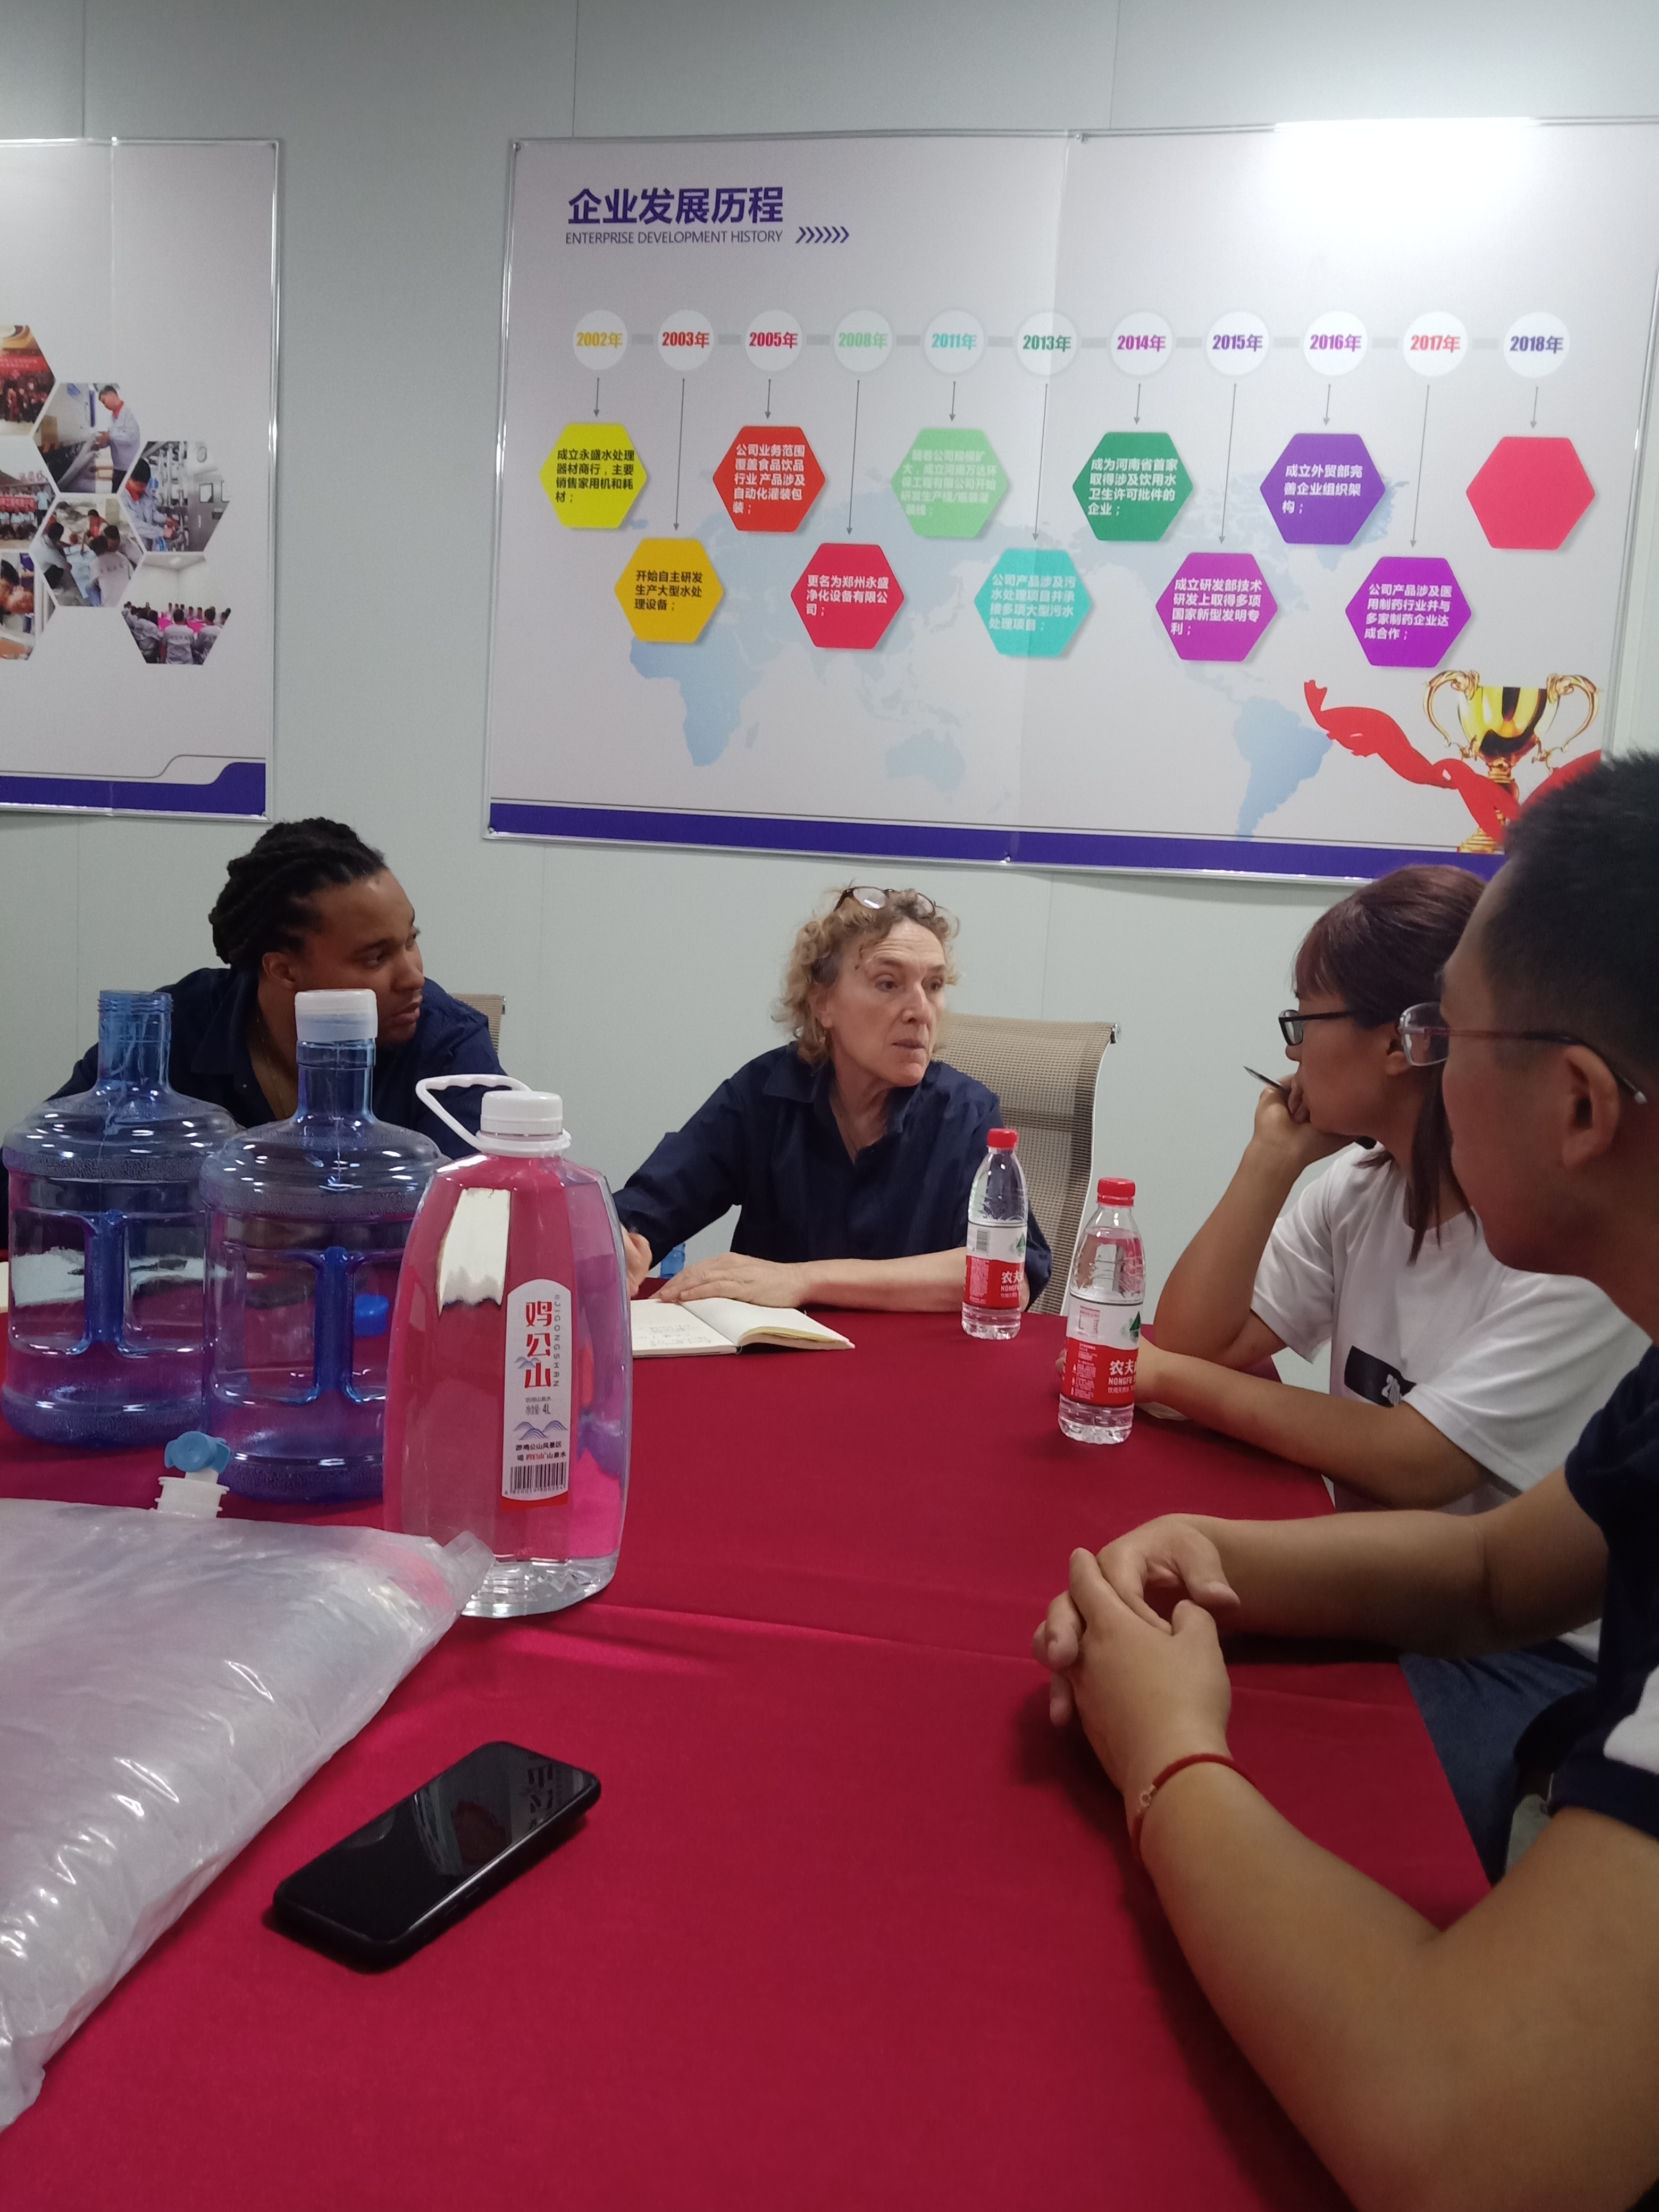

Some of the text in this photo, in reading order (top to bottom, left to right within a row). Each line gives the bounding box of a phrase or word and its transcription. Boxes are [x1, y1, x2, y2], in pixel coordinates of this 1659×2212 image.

[568, 187, 783, 224] 企业发展历程
[565, 230, 783, 244] ENTERPRISE DEVELOPMENT HISTORY
[577, 331, 623, 349] 2002年
[662, 331, 710, 349] 2003年
[749, 331, 798, 349] 2005年
[839, 332, 887, 350] 2008年
[932, 333, 977, 350] 2011年
[1023, 334, 1071, 352] 2013年
[1118, 334, 1166, 353] 2014年
[1212, 334, 1263, 352] 2015年
[1310, 334, 1362, 353] 2016年
[1410, 334, 1461, 353] 2017年
[1510, 336, 1563, 354] 2018年
[557, 449, 634, 461] 成立永盛水处理
[736, 443, 806, 457] 公司业务范围
[735, 458, 804, 472] 覆盖食品饮品
[1091, 457, 1178, 472] 成为河南省首家
[1285, 463, 1363, 479] 成立外贸部完
[556, 477, 633, 490] 销售家用机和耗
[1090, 472, 1177, 487] 取得涉及饮用水
[734, 487, 802, 501] 自动化灌装包
[1088, 487, 1176, 501] 卫生许可批件的
[1284, 481, 1361, 497] 善企业组织架
[636, 570, 703, 583] 开始自主研发
[807, 574, 889, 590] 更名为郑州永盛
[1174, 577, 1263, 592] 成立研发部技术
[635, 584, 702, 598] 生产大型水处
[806, 589, 888, 604] 净化设备有限公
[1369, 583, 1453, 598] 公司产品涉及医
[1173, 592, 1262, 608] 研发上取得多项
[1367, 598, 1451, 613] 用制药行业并与
[1172, 607, 1260, 623] 国家新型发明专
[1365, 612, 1449, 627] 多家制药企业达
[524, 1301, 552, 1388] 鸡公山
[1109, 1359, 1136, 1376] 农夫
